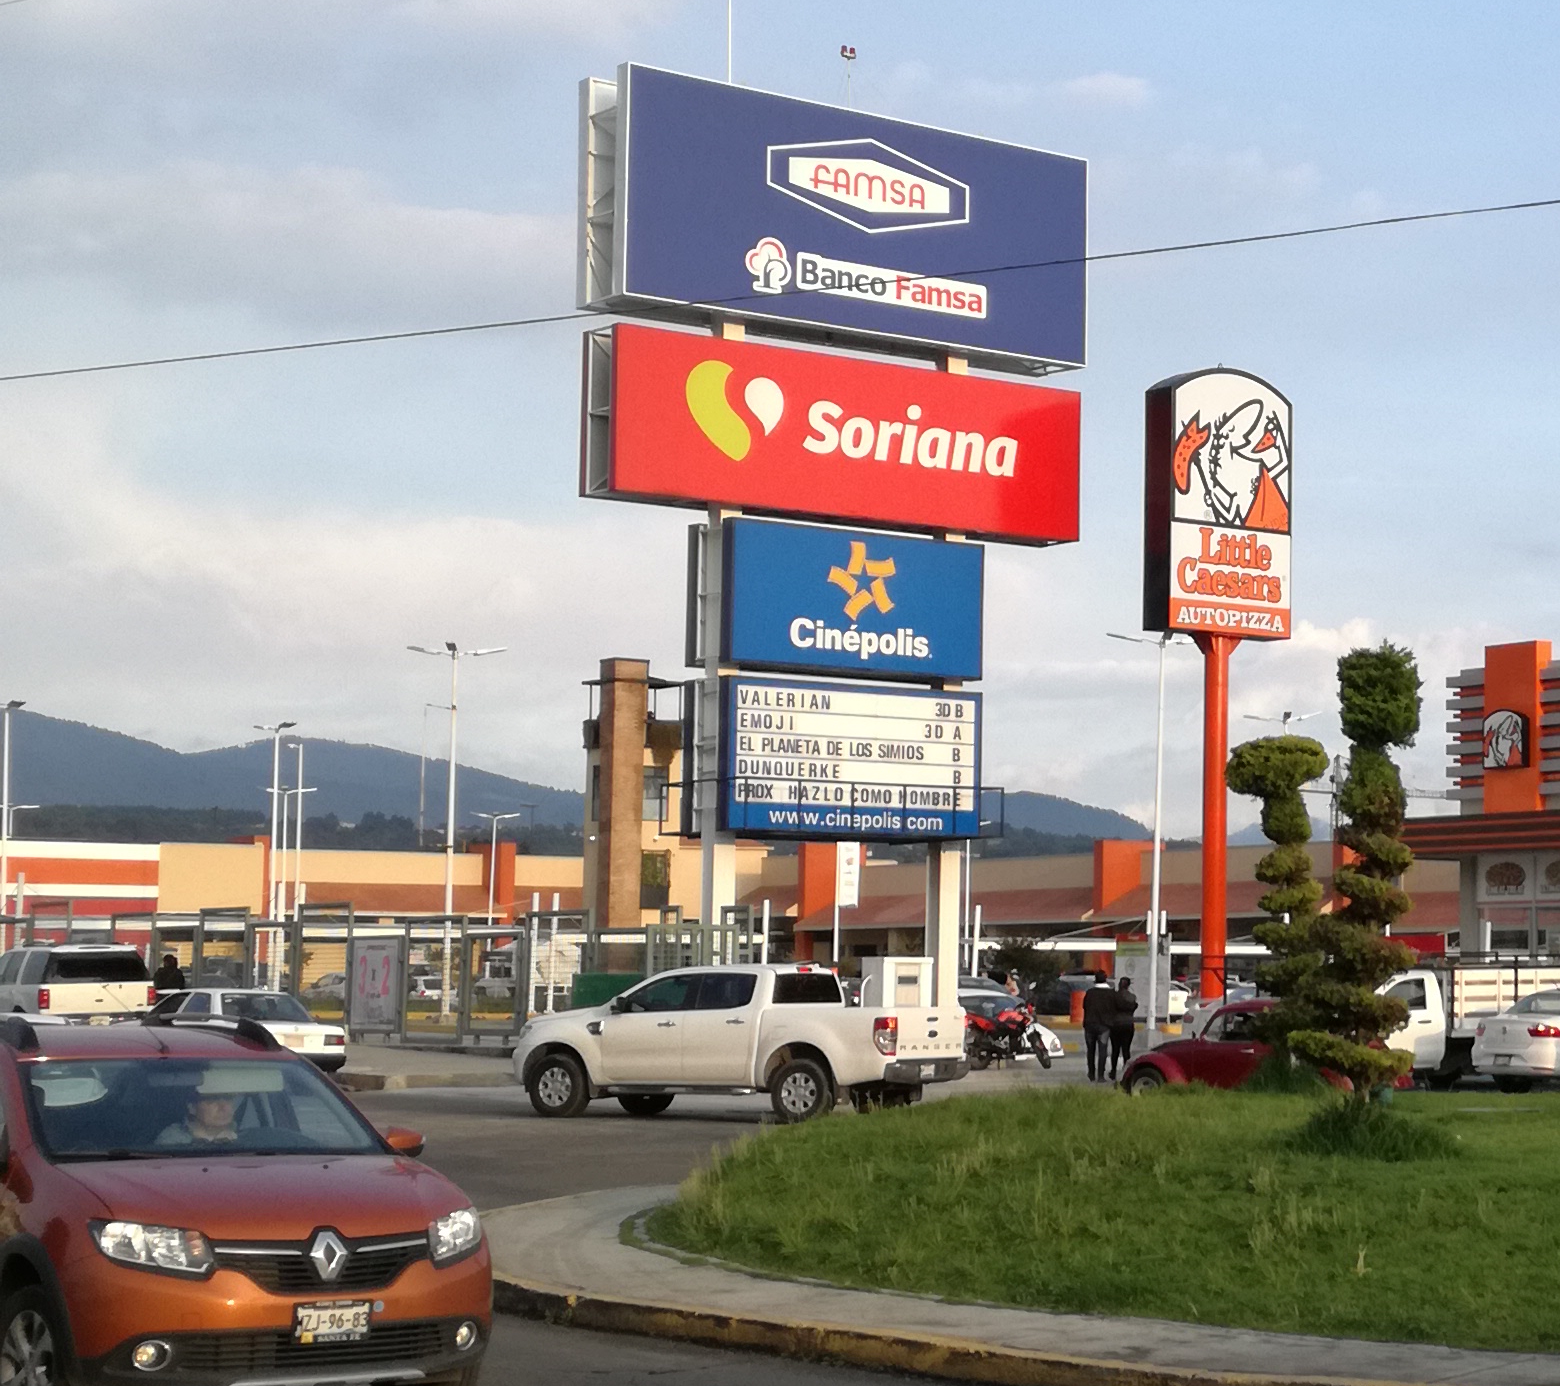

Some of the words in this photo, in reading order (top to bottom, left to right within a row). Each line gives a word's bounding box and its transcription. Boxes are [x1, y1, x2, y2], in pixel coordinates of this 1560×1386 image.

[808, 163, 926, 211] FAMSA
[801, 258, 887, 298] Banco
[895, 274, 984, 315] Famsa
[802, 399, 1019, 478] Soriana
[1198, 527, 1273, 572] Little
[1177, 556, 1282, 604] Caesars
[1176, 605, 1285, 633] AUTOPIZZA
[789, 617, 930, 660] Cinépolis
[739, 689, 832, 710] VALERIAN
[934, 702, 951, 718] 3D
[954, 703, 964, 718] B
[739, 713, 794, 731] EMOJI
[924, 723, 944, 739] 3D
[953, 725, 962, 741] A
[739, 736, 756, 752] EL
[761, 737, 821, 756] PLANETA
[826, 741, 844, 757] DE
[849, 742, 873, 758] LOS
[877, 743, 925, 761] SIMIOS
[952, 747, 961, 763] B
[738, 759, 841, 779] DUNQUERKE
[953, 770, 962, 785] B
[788, 784, 844, 802] HAZLO
[768, 808, 944, 832] www.cinepoliscom
[899, 1042, 962, 1051] RANGER
